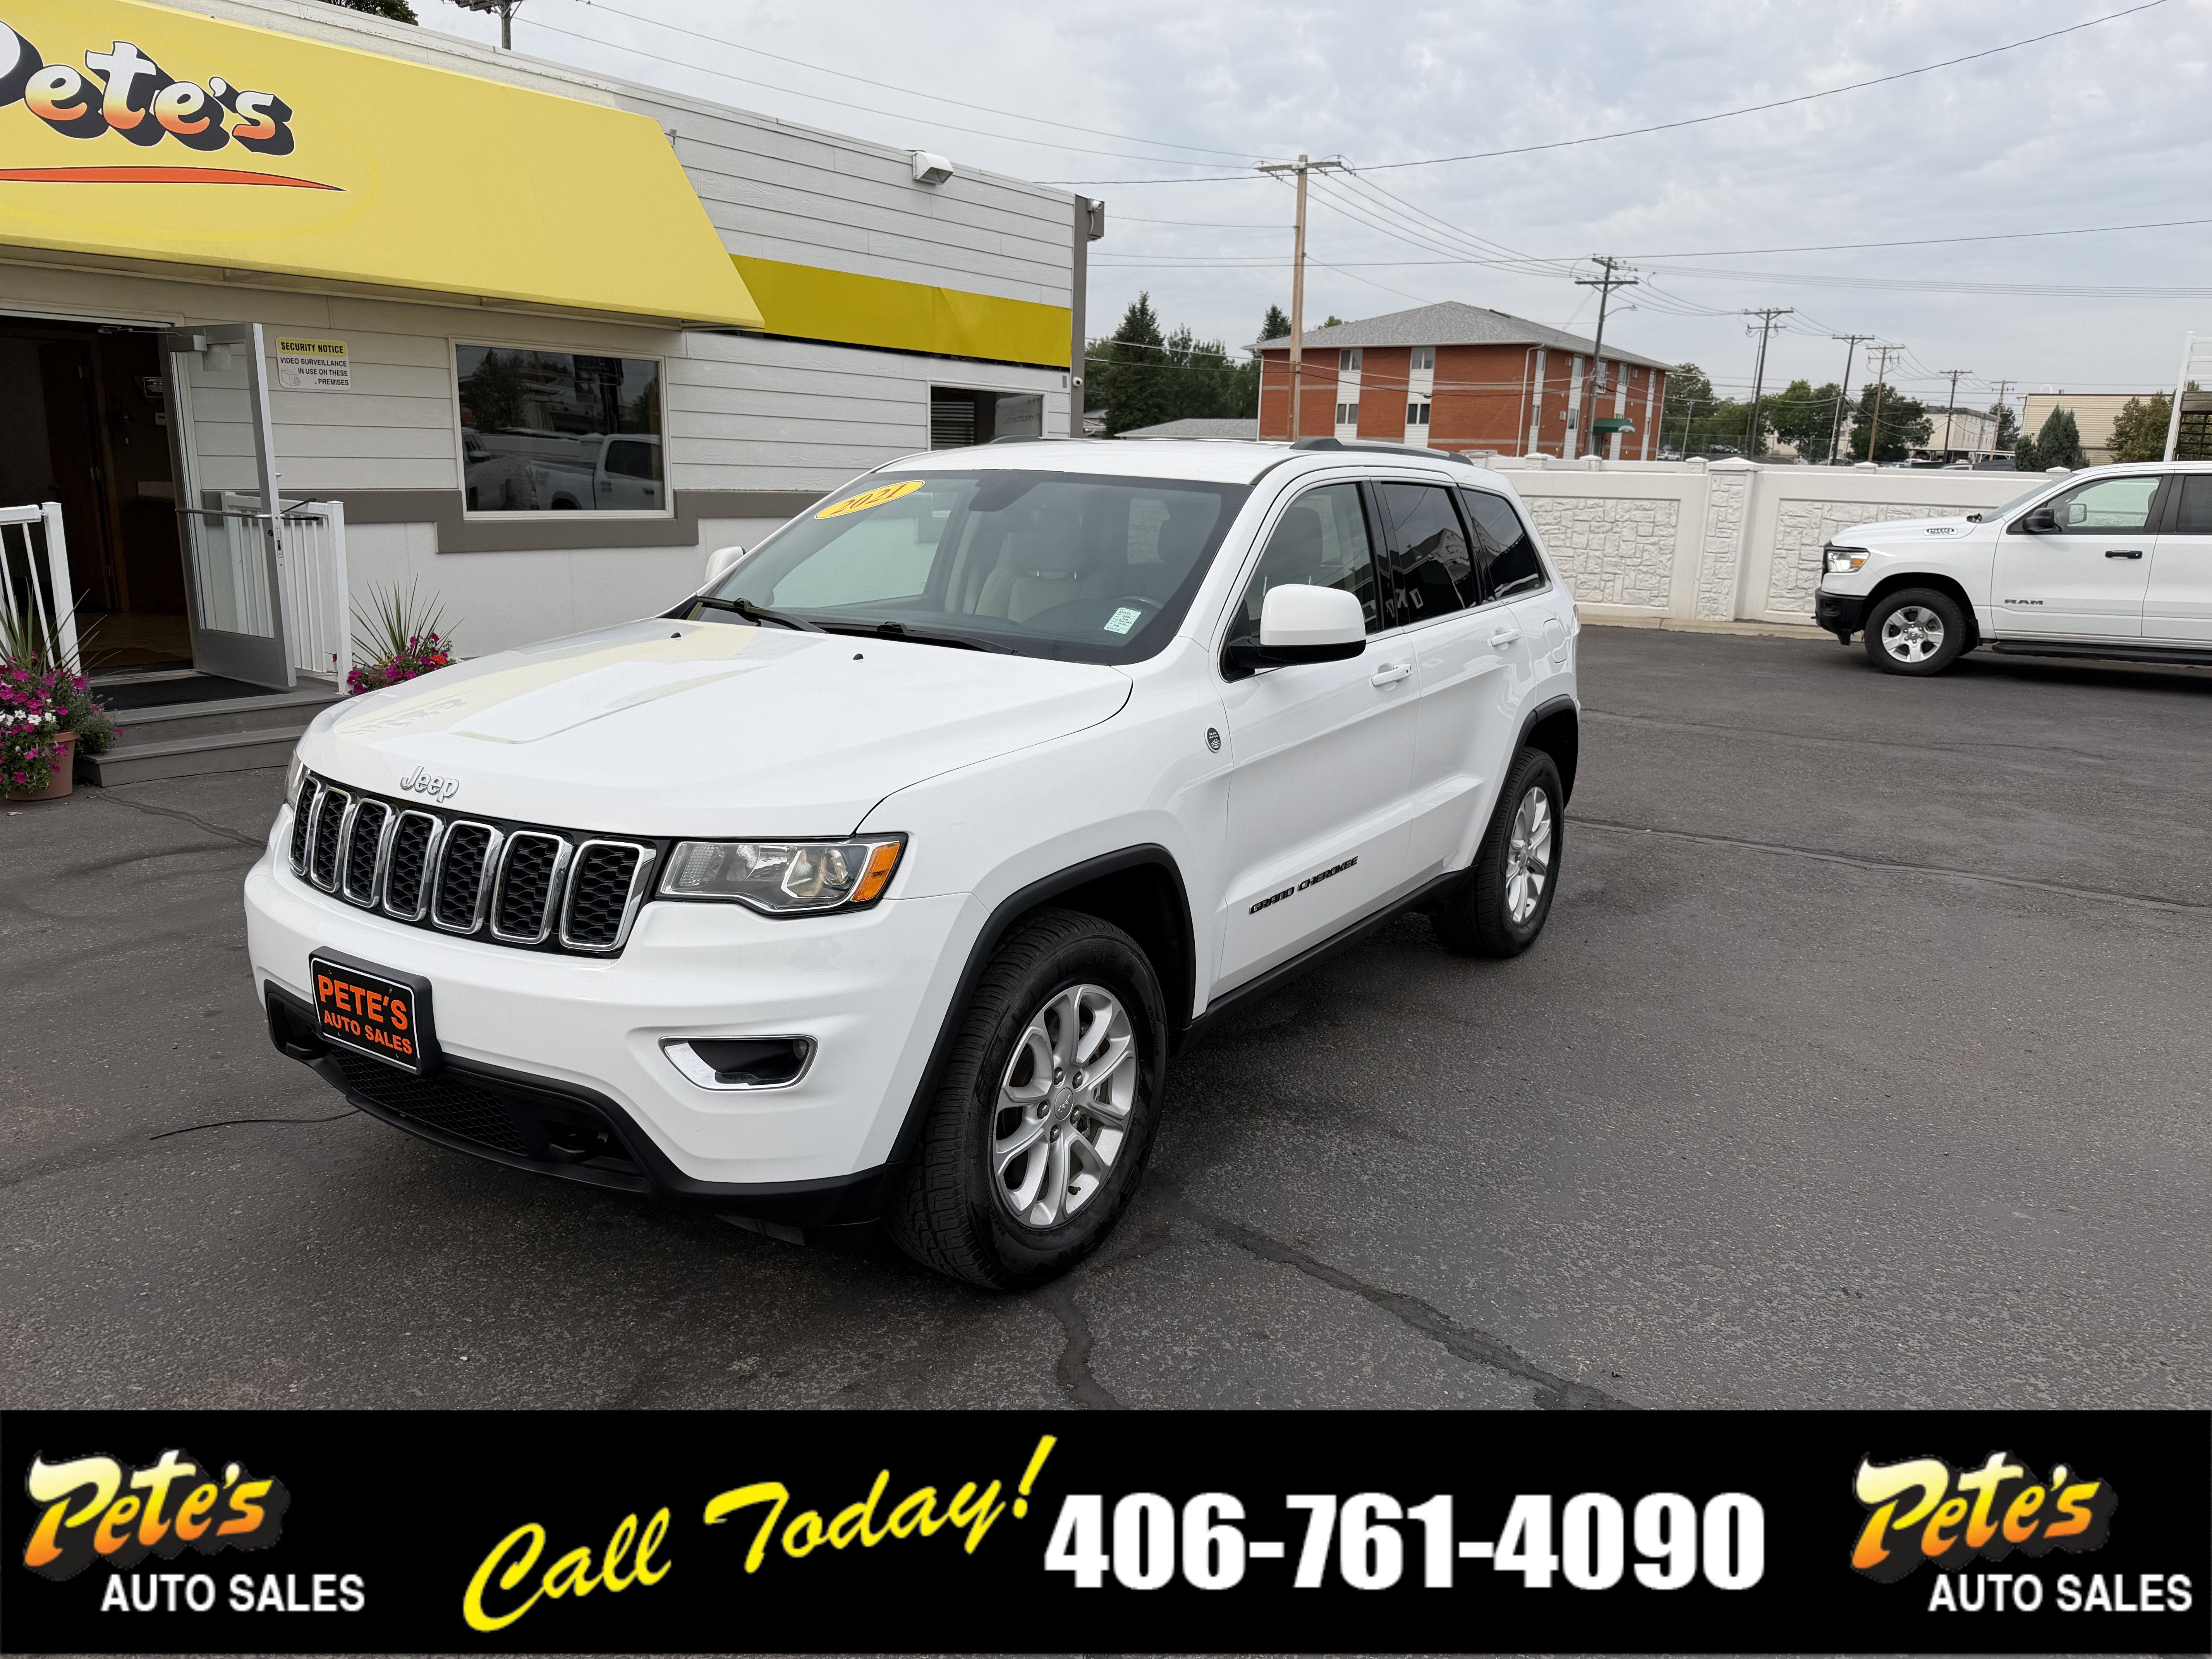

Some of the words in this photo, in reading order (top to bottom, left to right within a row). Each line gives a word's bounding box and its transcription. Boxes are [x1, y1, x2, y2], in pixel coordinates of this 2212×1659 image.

[0, 21, 294, 155] ete's
[281, 342, 315, 352] SECURITY
[318, 344, 343, 354] NOTICE
[301, 359, 347, 367] SURVEILLANCE
[830, 483, 908, 515] 2021
[400, 766, 459, 803] Jeep
[1249, 886, 1295, 915] GRAND
[1297, 856, 1358, 891] CHEROKEE
[318, 975, 408, 1030] PETE'S
[324, 1010, 361, 1036] AUTO
[365, 1025, 412, 1054] SALES
